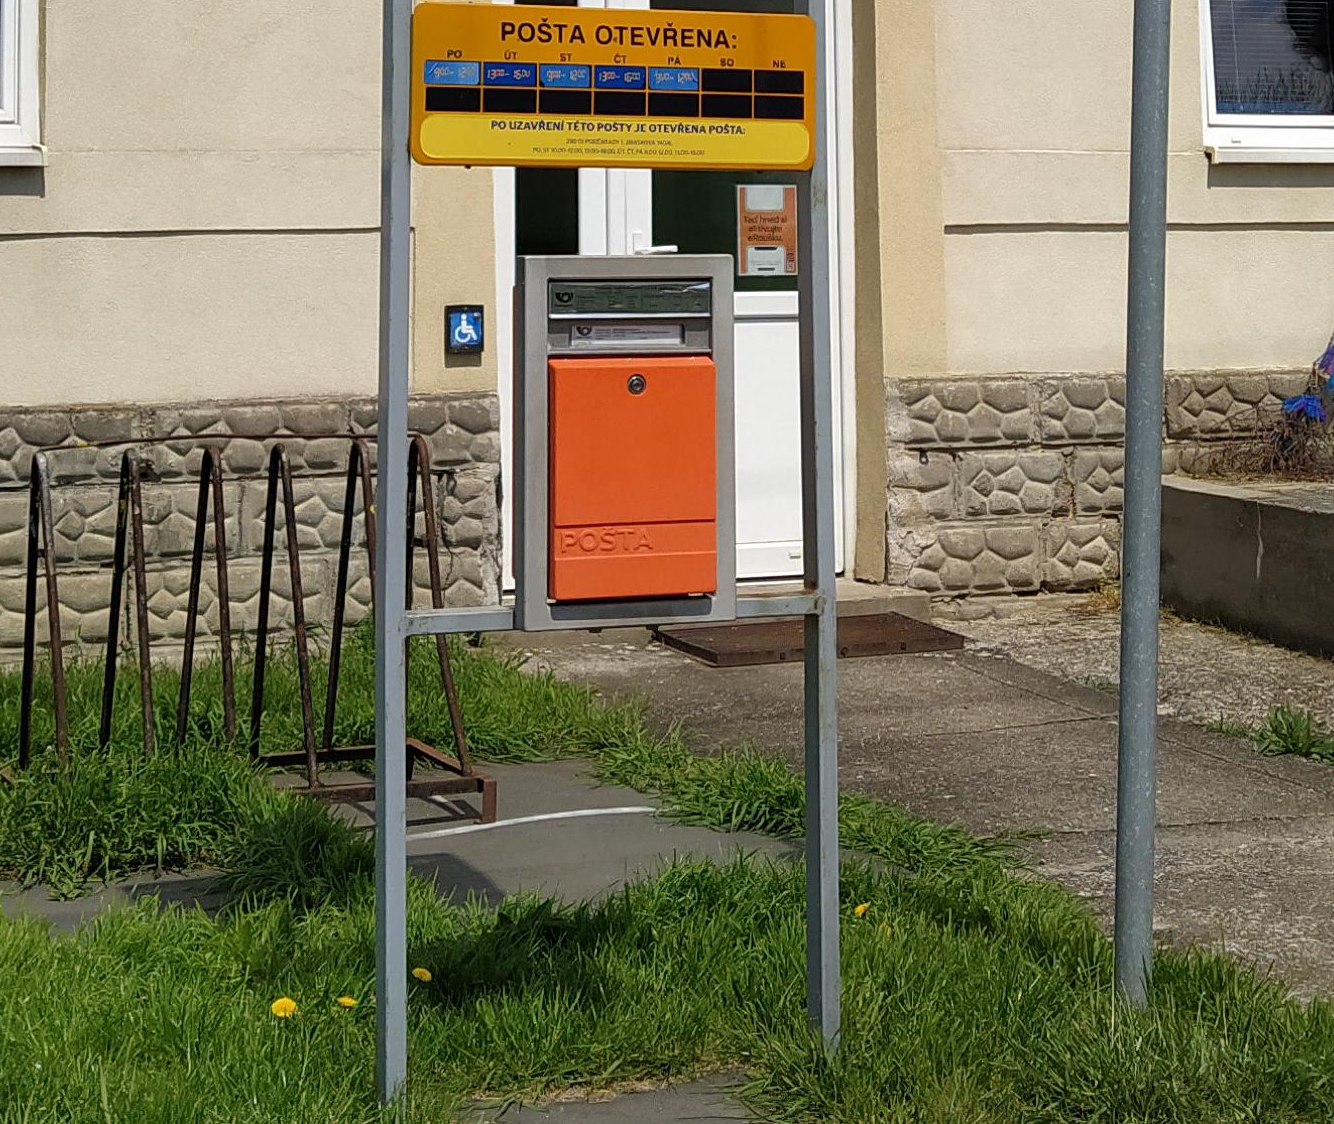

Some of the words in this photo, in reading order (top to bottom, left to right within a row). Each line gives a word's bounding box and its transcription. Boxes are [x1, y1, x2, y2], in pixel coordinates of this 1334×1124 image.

[500, 18, 586, 44] POŠTA
[595, 22, 738, 49] OTEVŘENA:
[447, 49, 462, 59] PO
[504, 49, 518, 60] ÚT
[560, 53, 572, 62] ST
[613, 53, 627, 64] ČT
[668, 55, 682, 65] PÁ
[720, 58, 734, 67] SO
[772, 60, 786, 68] NE
[491, 120, 507, 130] PO
[509, 119, 564, 131] UZAVŘENÍ
[566, 120, 595, 131] TÉTO
[596, 122, 633, 132] POŠTY
[635, 123, 646, 133] JE
[649, 123, 706, 134] OTEVŘENA
[708, 123, 746, 135] POŠTA:
[560, 526, 654, 554] POŠTA
